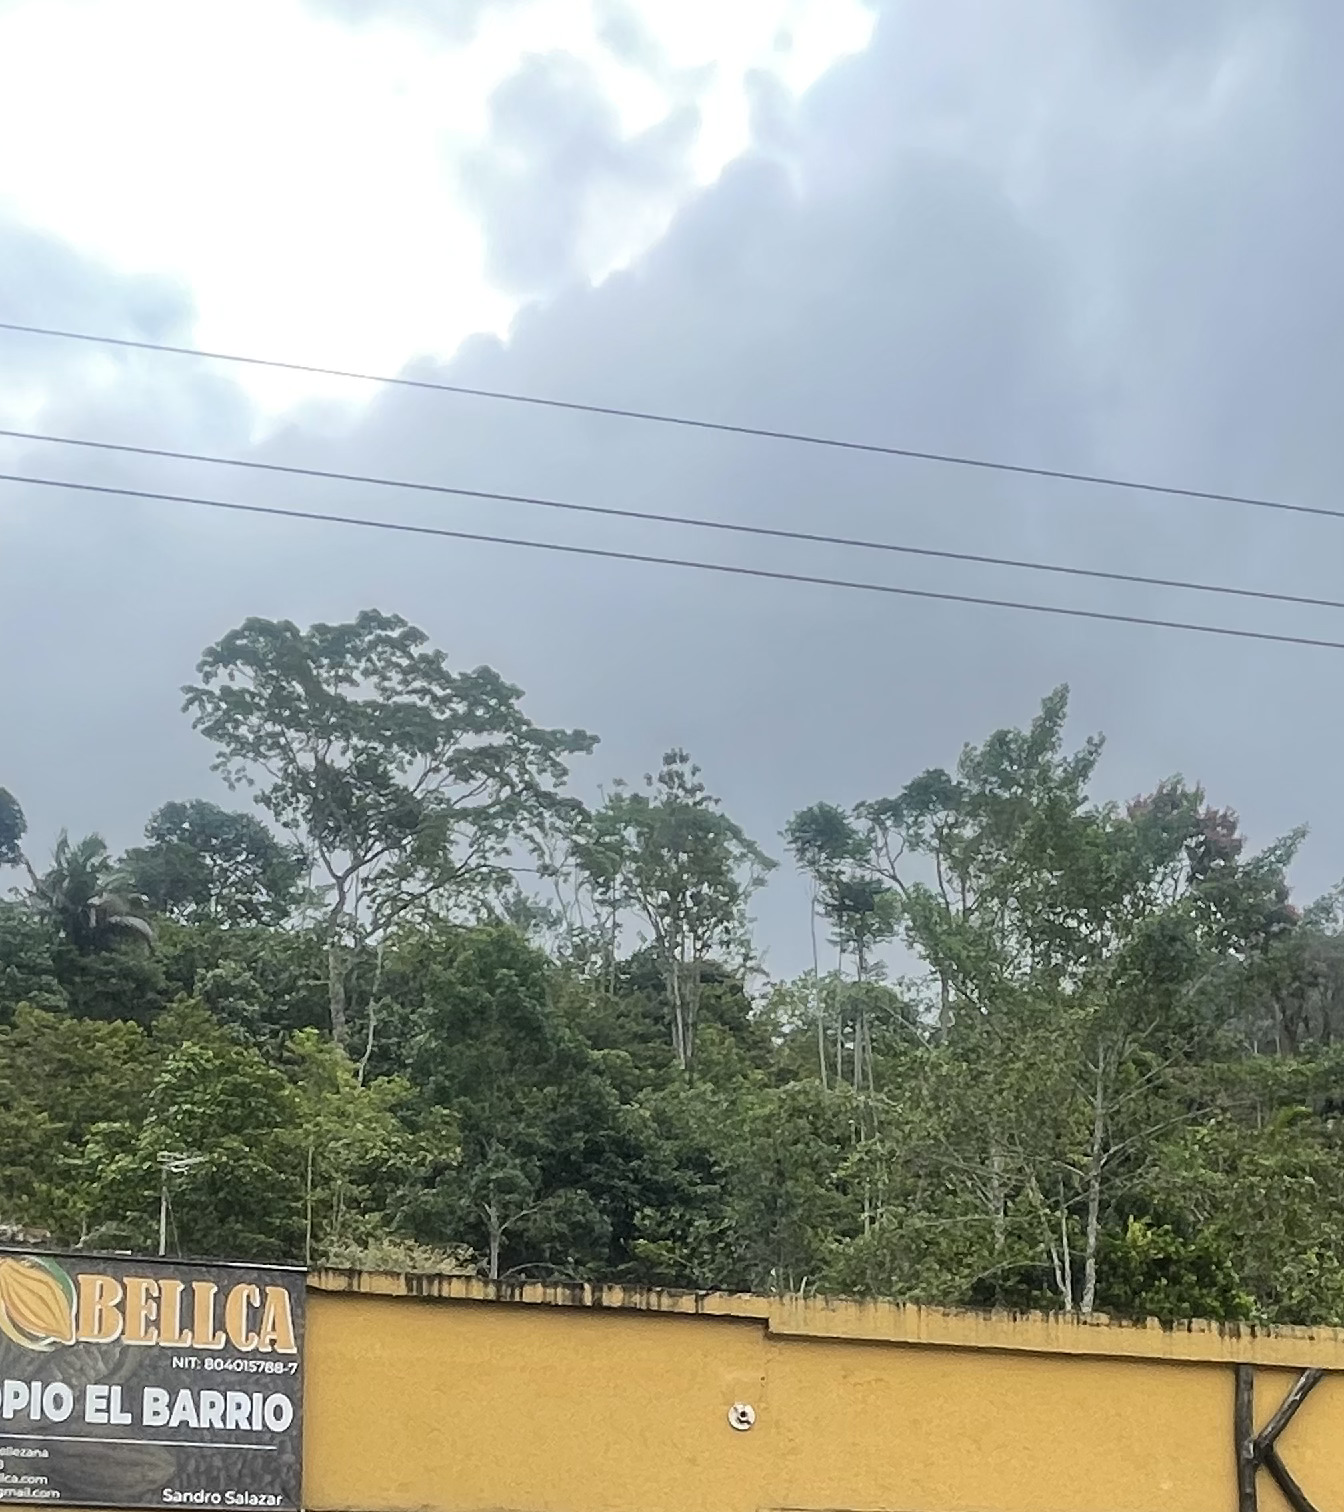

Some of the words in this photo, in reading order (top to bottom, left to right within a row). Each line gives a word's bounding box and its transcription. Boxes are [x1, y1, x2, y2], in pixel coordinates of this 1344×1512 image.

[172, 1356, 201, 1370] NIT:
[84, 1384, 132, 1425] EL
[142, 1386, 294, 1432] BARRIO
[162, 1488, 222, 1504] Sandro
[224, 1490, 283, 1506] Salazar
